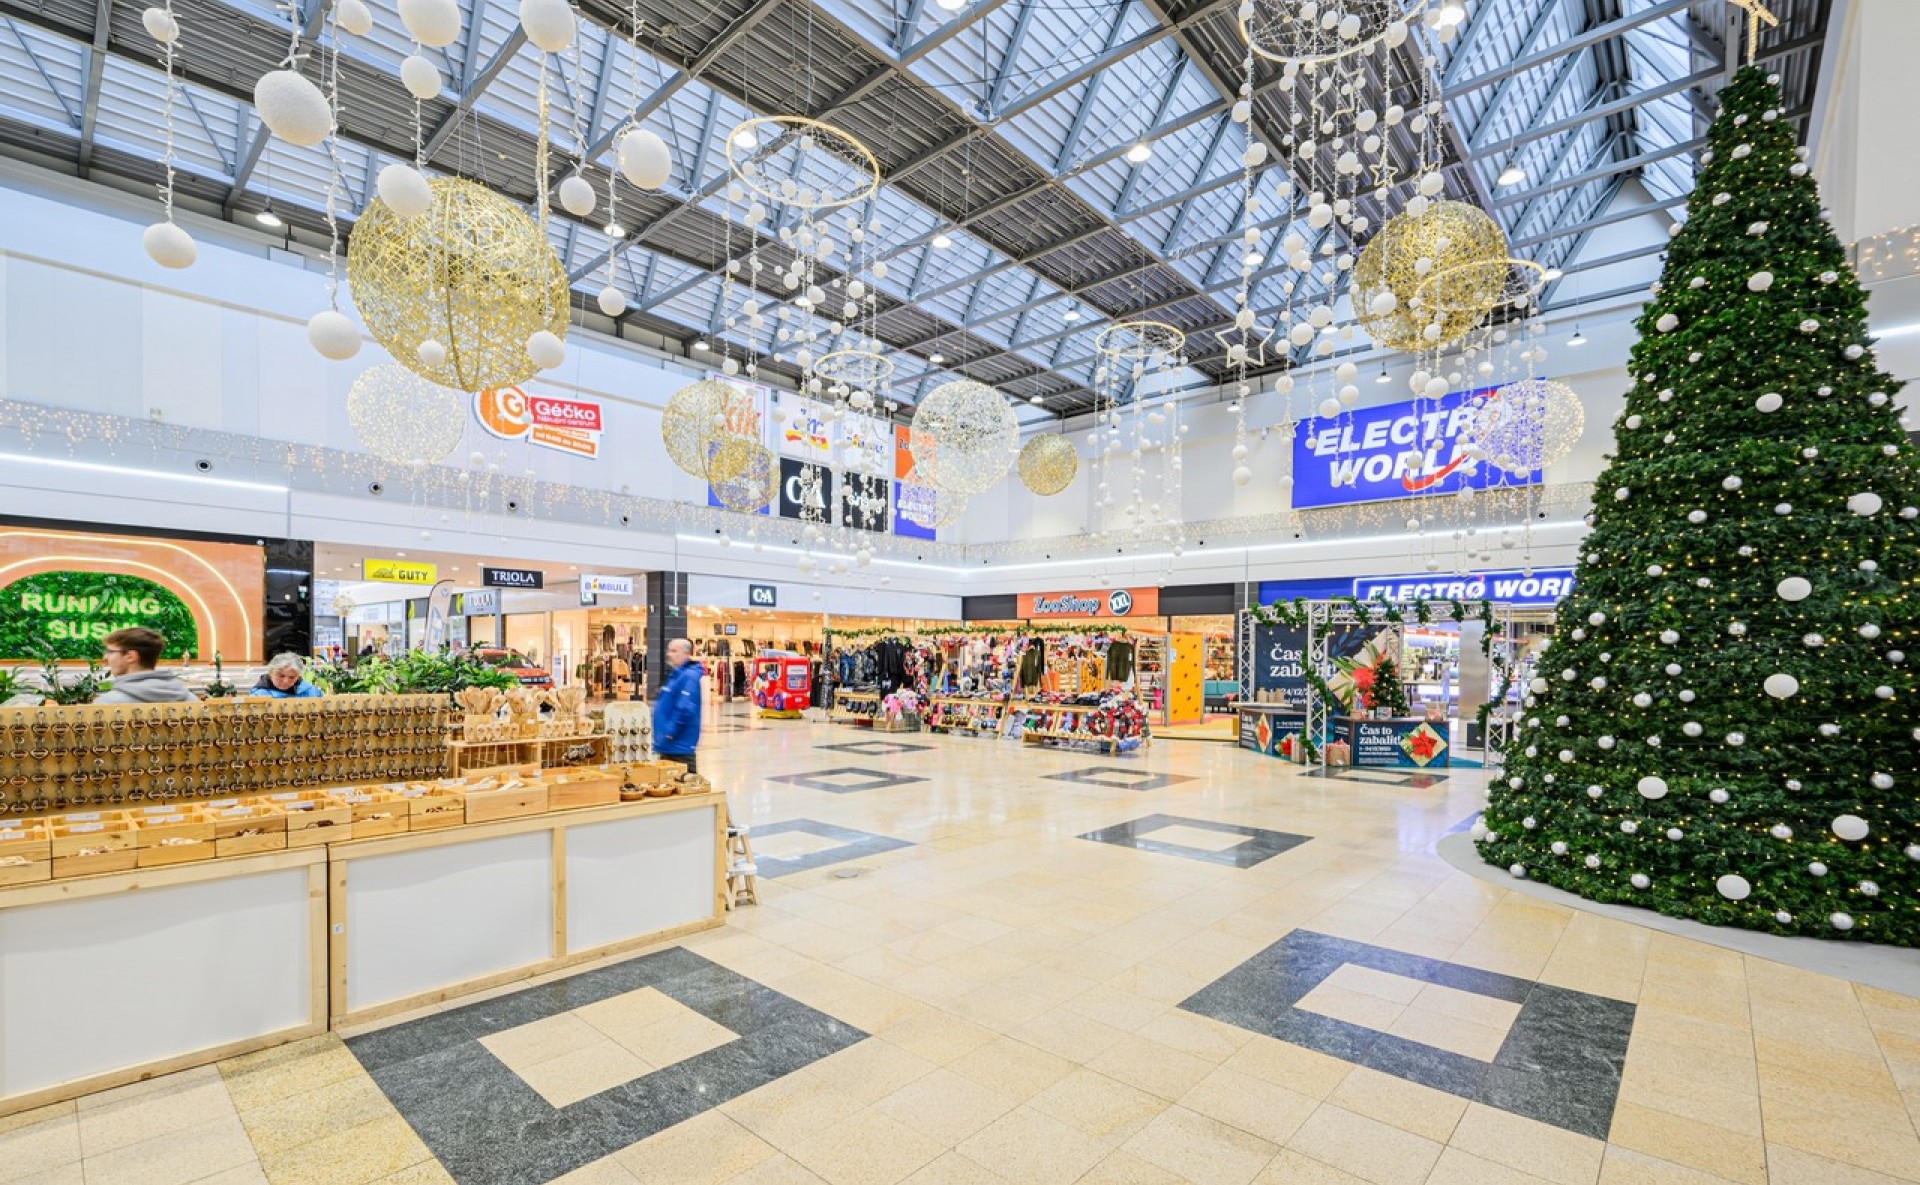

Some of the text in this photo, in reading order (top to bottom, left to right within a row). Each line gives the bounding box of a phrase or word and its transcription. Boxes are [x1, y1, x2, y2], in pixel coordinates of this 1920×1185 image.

[534, 400, 597, 420] Géčko
[786, 475, 826, 508] CA
[398, 570, 428, 581] GUTY
[491, 571, 535, 583] TRIOLA
[1493, 577, 1573, 598] WORL
[1033, 595, 1101, 616] ZooShop
[1270, 642, 1303, 661] Čas
[1359, 723, 1381, 735] Čas
[1381, 726, 1393, 735] to
[1358, 735, 1401, 746] zabalit!
